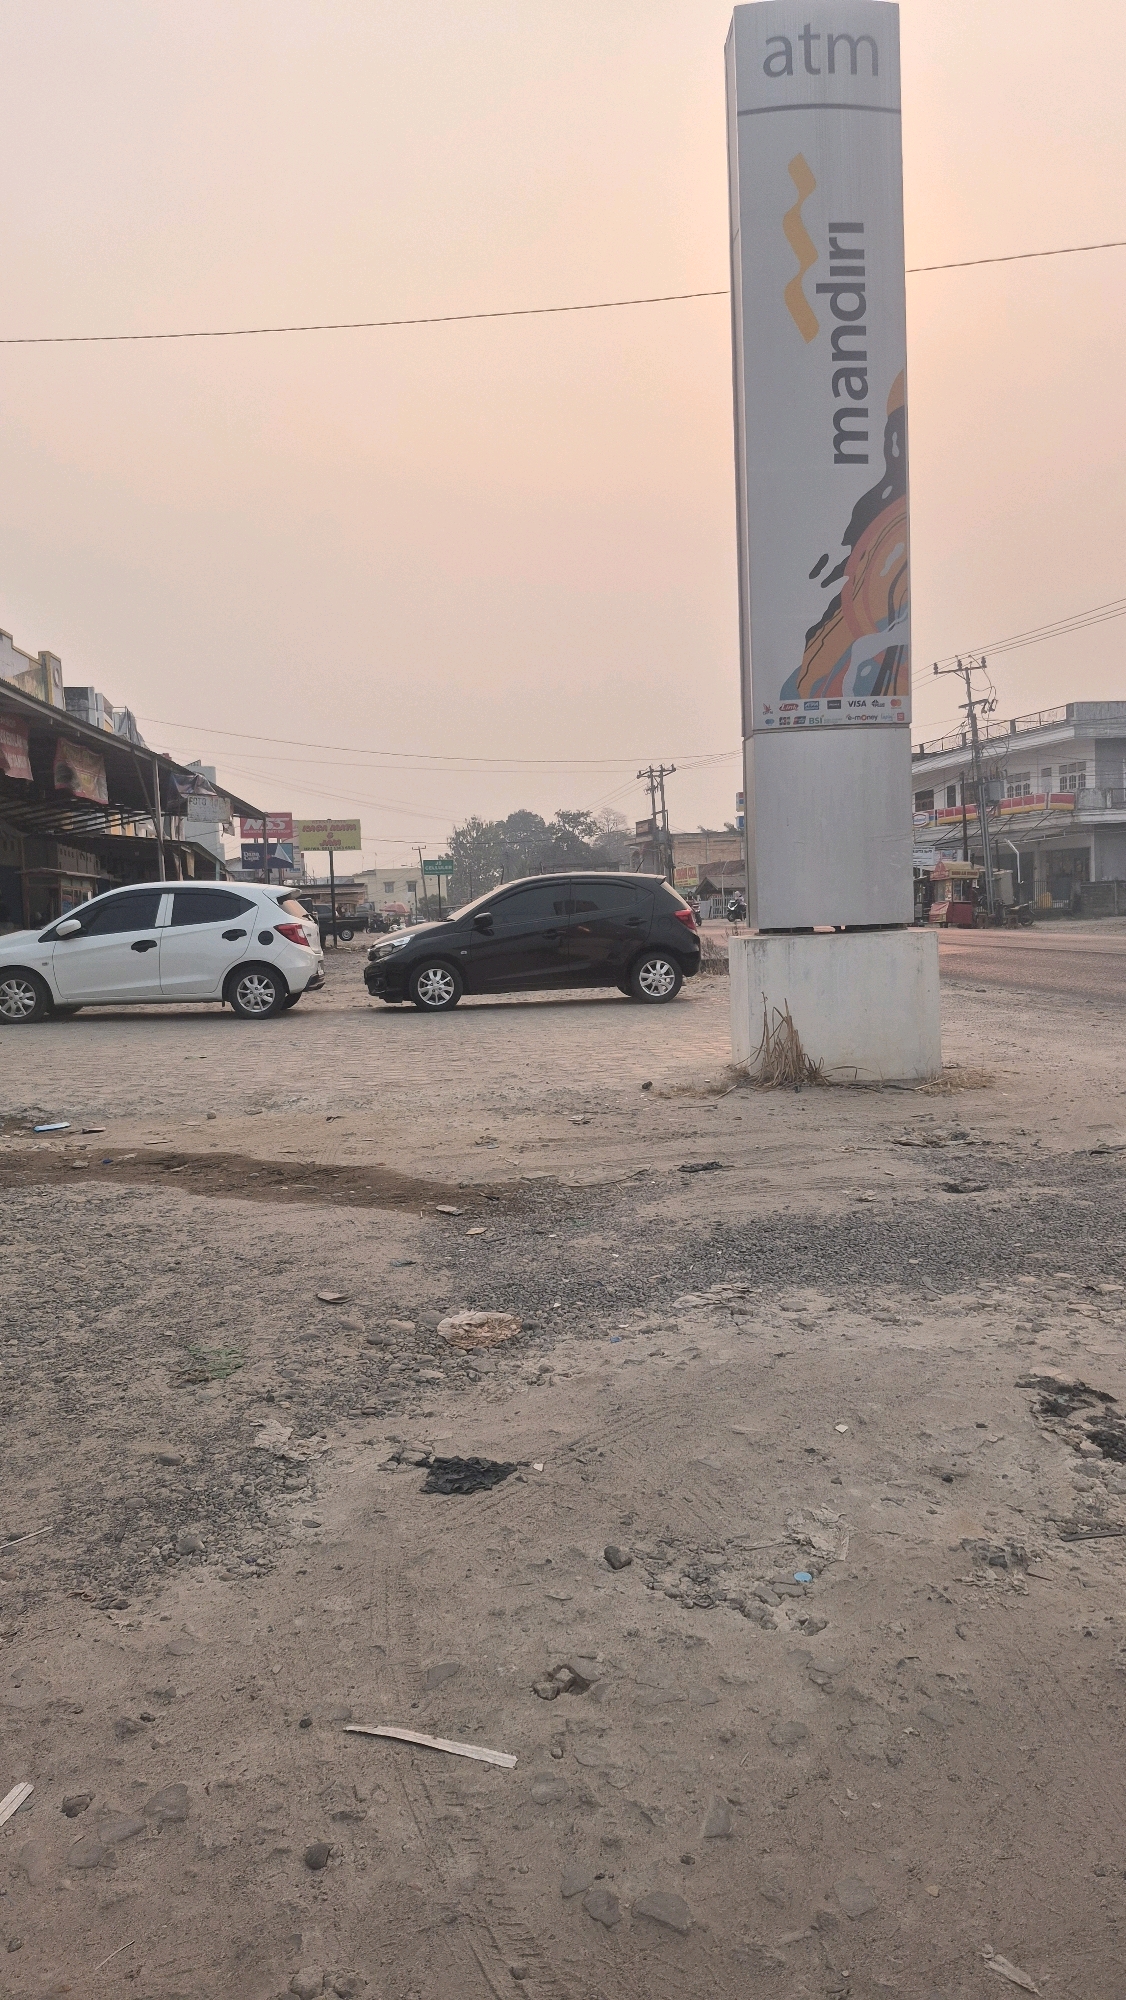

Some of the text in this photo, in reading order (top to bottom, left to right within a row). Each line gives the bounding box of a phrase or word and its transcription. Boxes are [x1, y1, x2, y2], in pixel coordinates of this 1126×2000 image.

[763, 23, 878, 78] atm
[816, 222, 869, 465] mandiri
[809, 715, 823, 725] BSI
